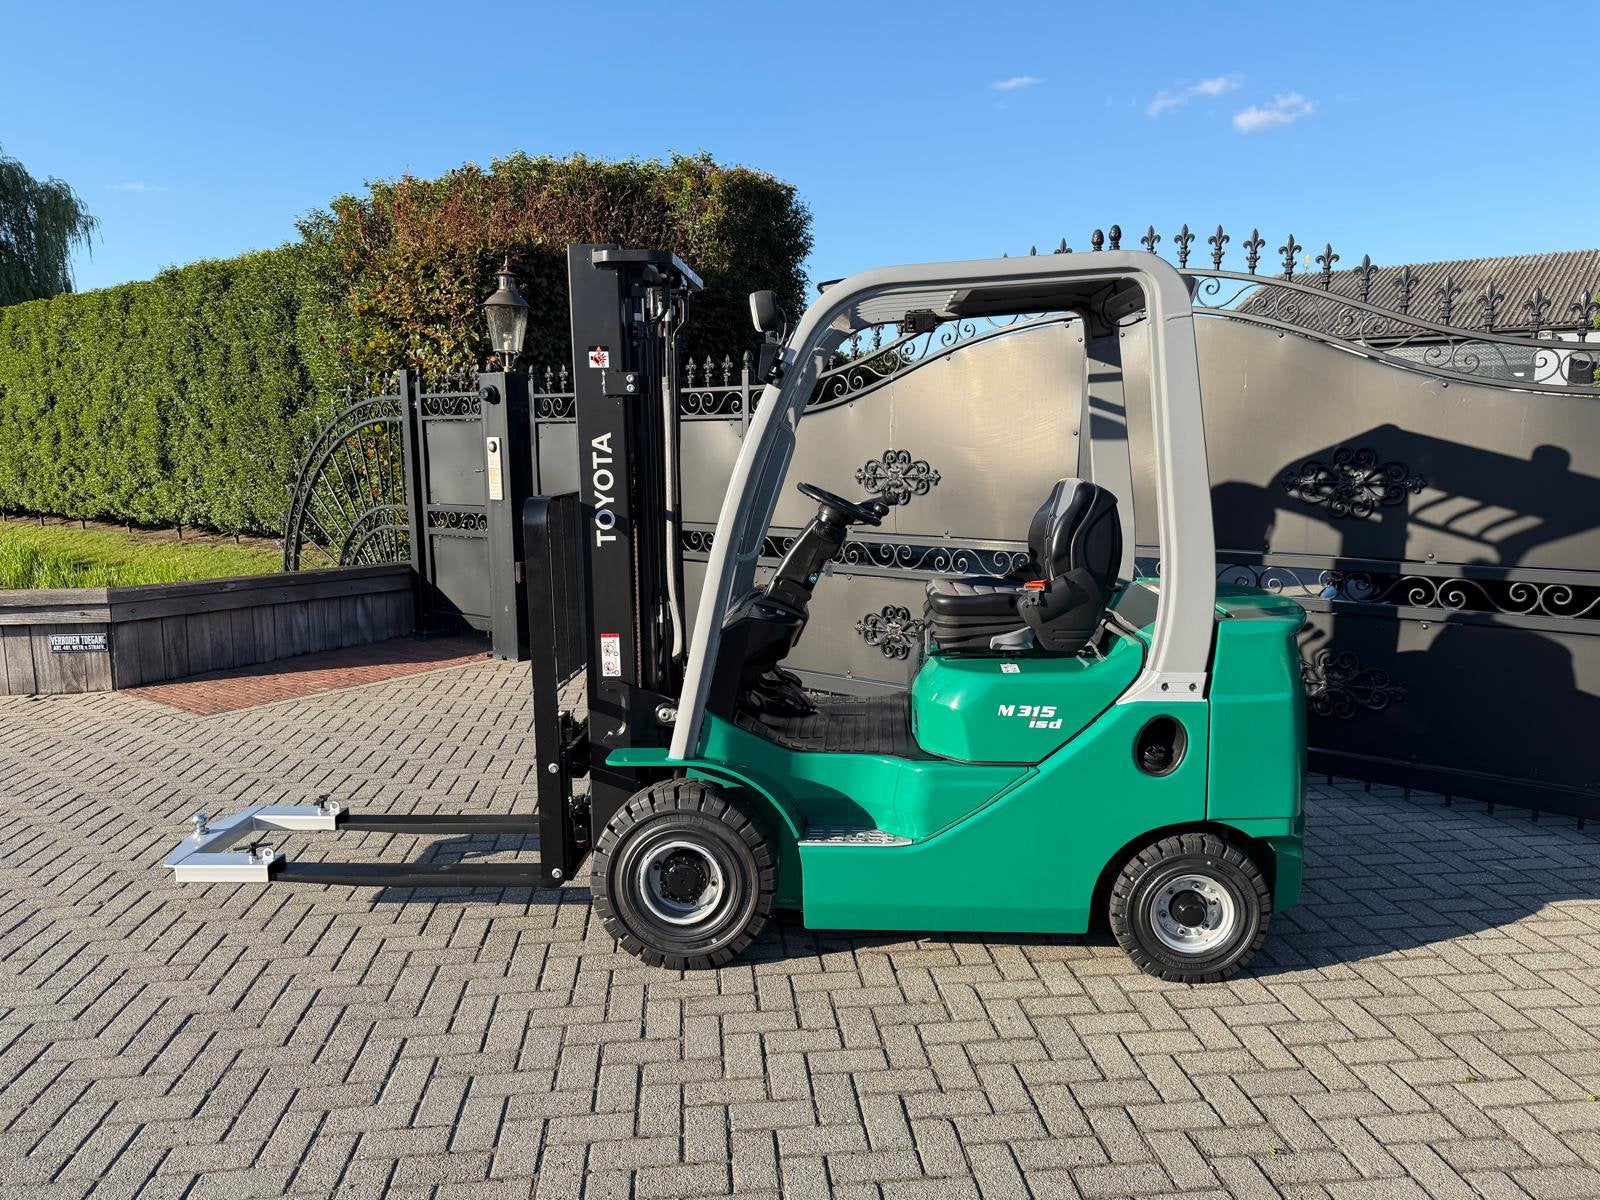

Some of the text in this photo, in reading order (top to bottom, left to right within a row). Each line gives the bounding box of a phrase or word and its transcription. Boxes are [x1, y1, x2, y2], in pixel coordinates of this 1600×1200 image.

[592, 432, 617, 547] TOYOTA
[51, 635, 106, 645] VERBODEN TOEGANG
[998, 705, 1057, 717] M 315
[1029, 716, 1063, 729] isd
